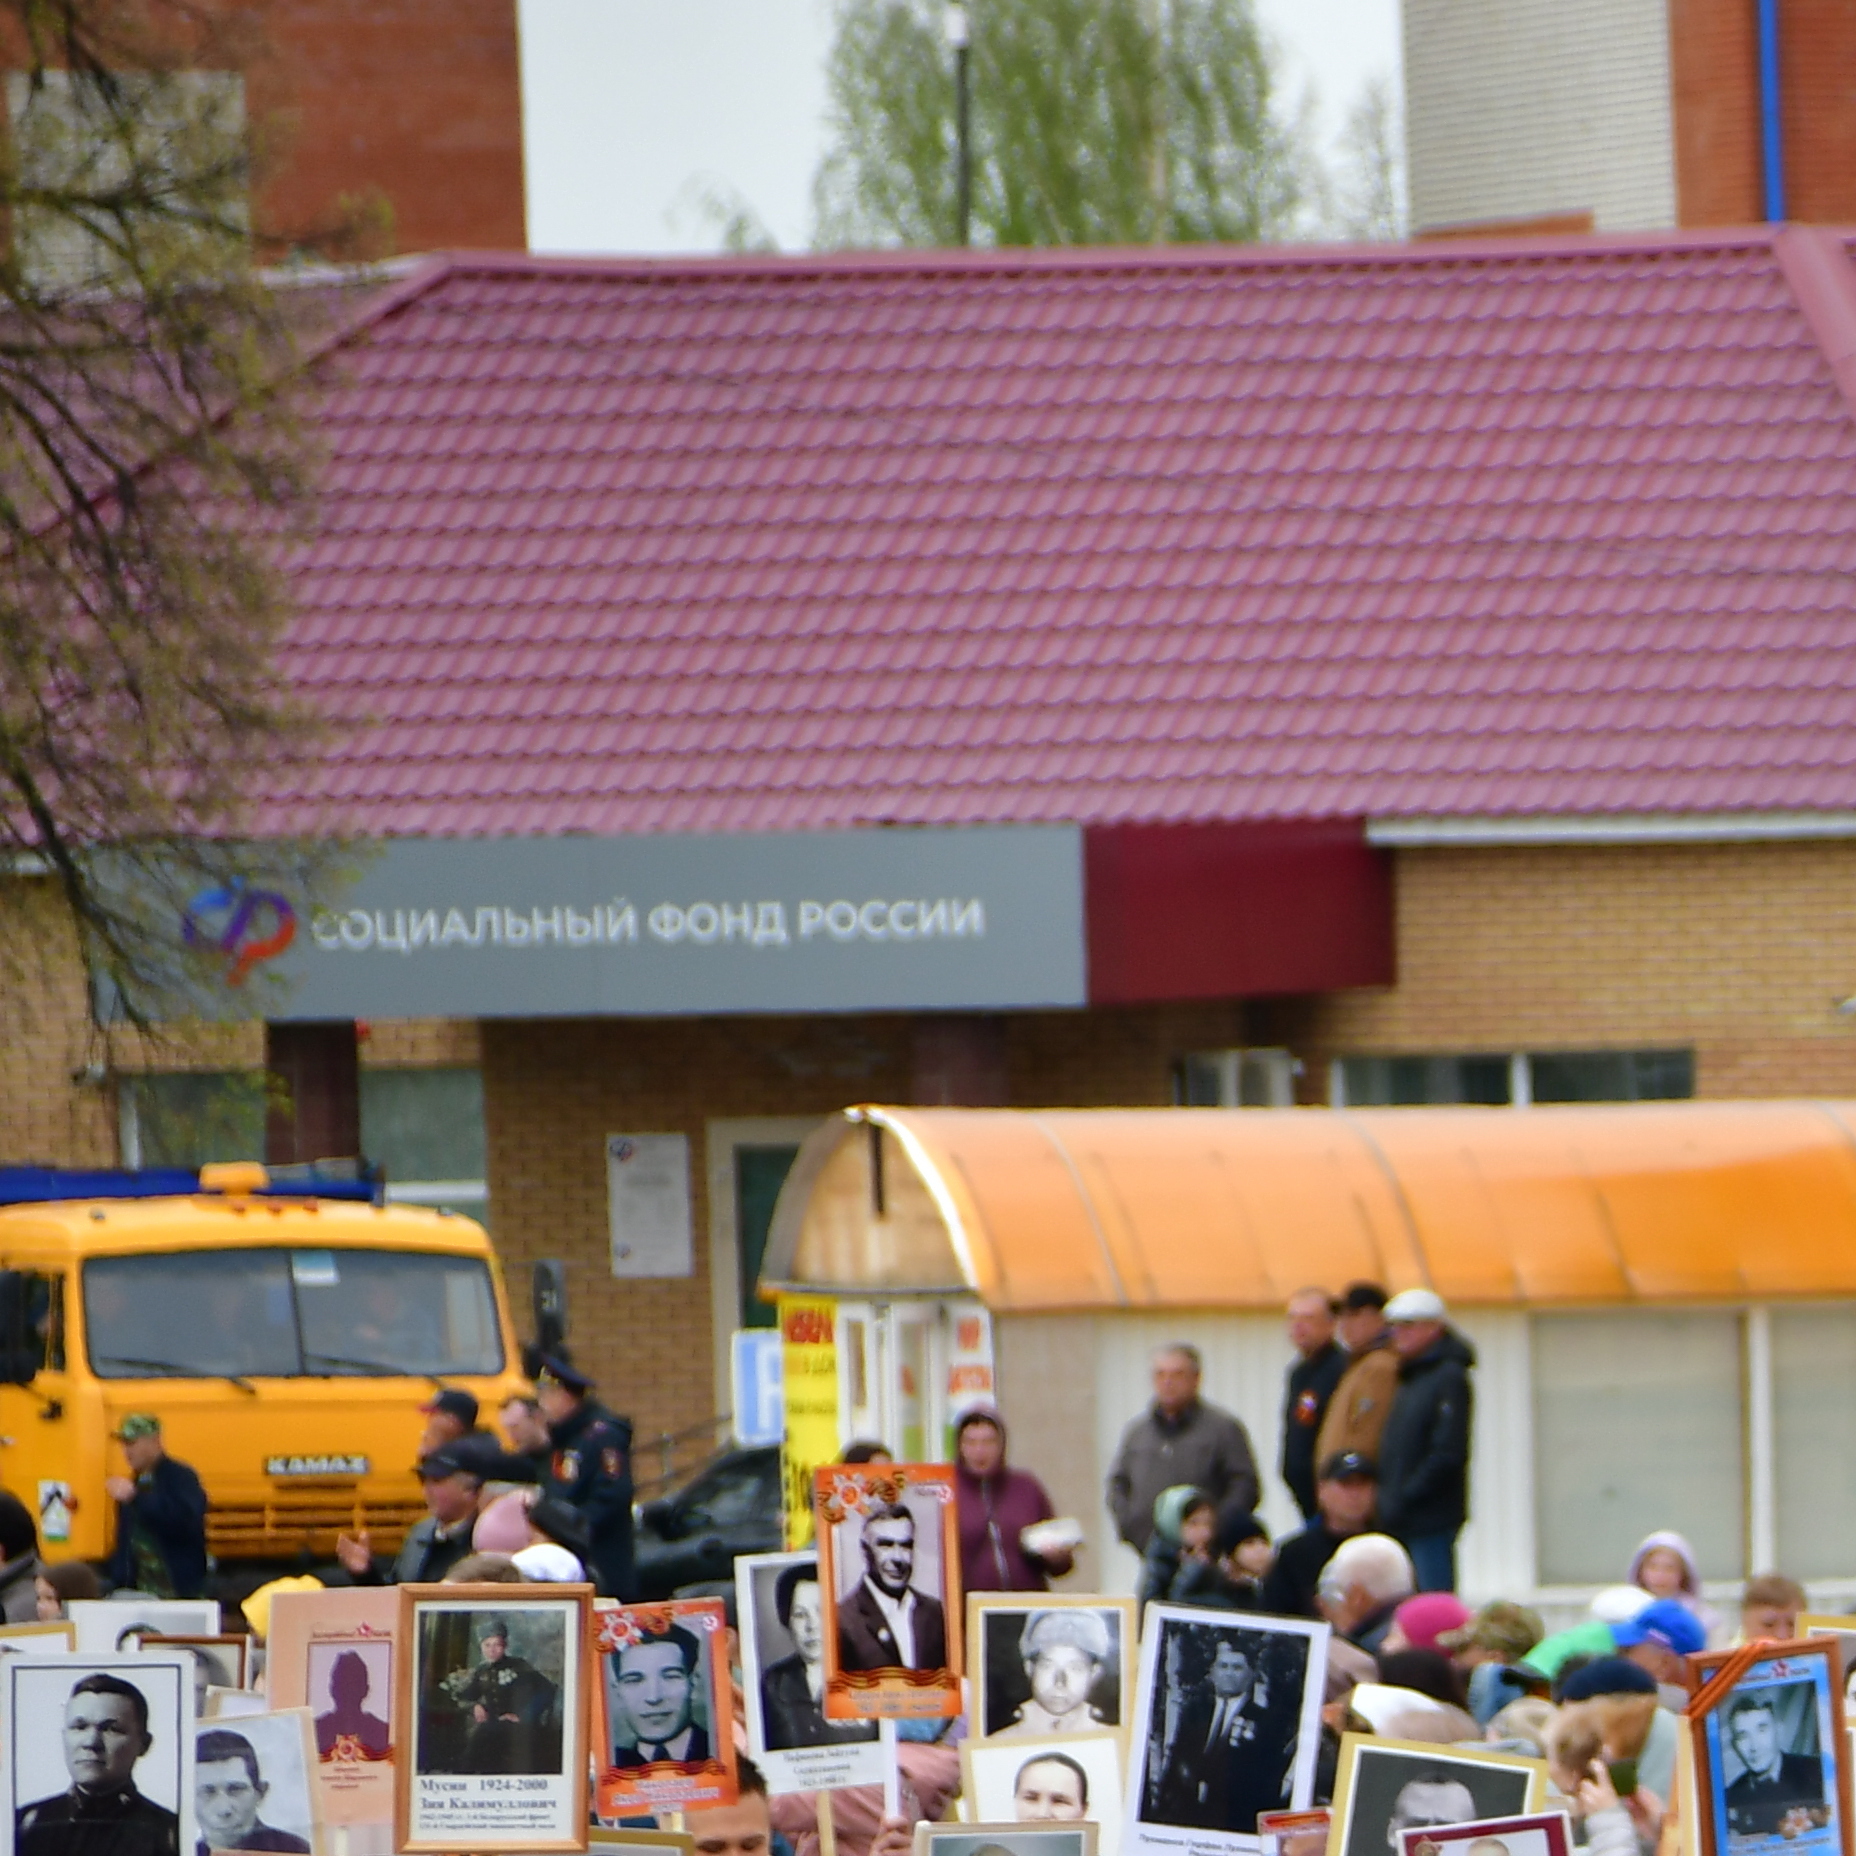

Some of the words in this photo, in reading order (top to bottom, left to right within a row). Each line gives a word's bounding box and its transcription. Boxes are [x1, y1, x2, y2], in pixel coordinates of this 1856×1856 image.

[310, 897, 635, 949] СОЦИАЛЬНЫЙ
[647, 900, 787, 946] ФОНД
[799, 896, 985, 942] РОССИИ
